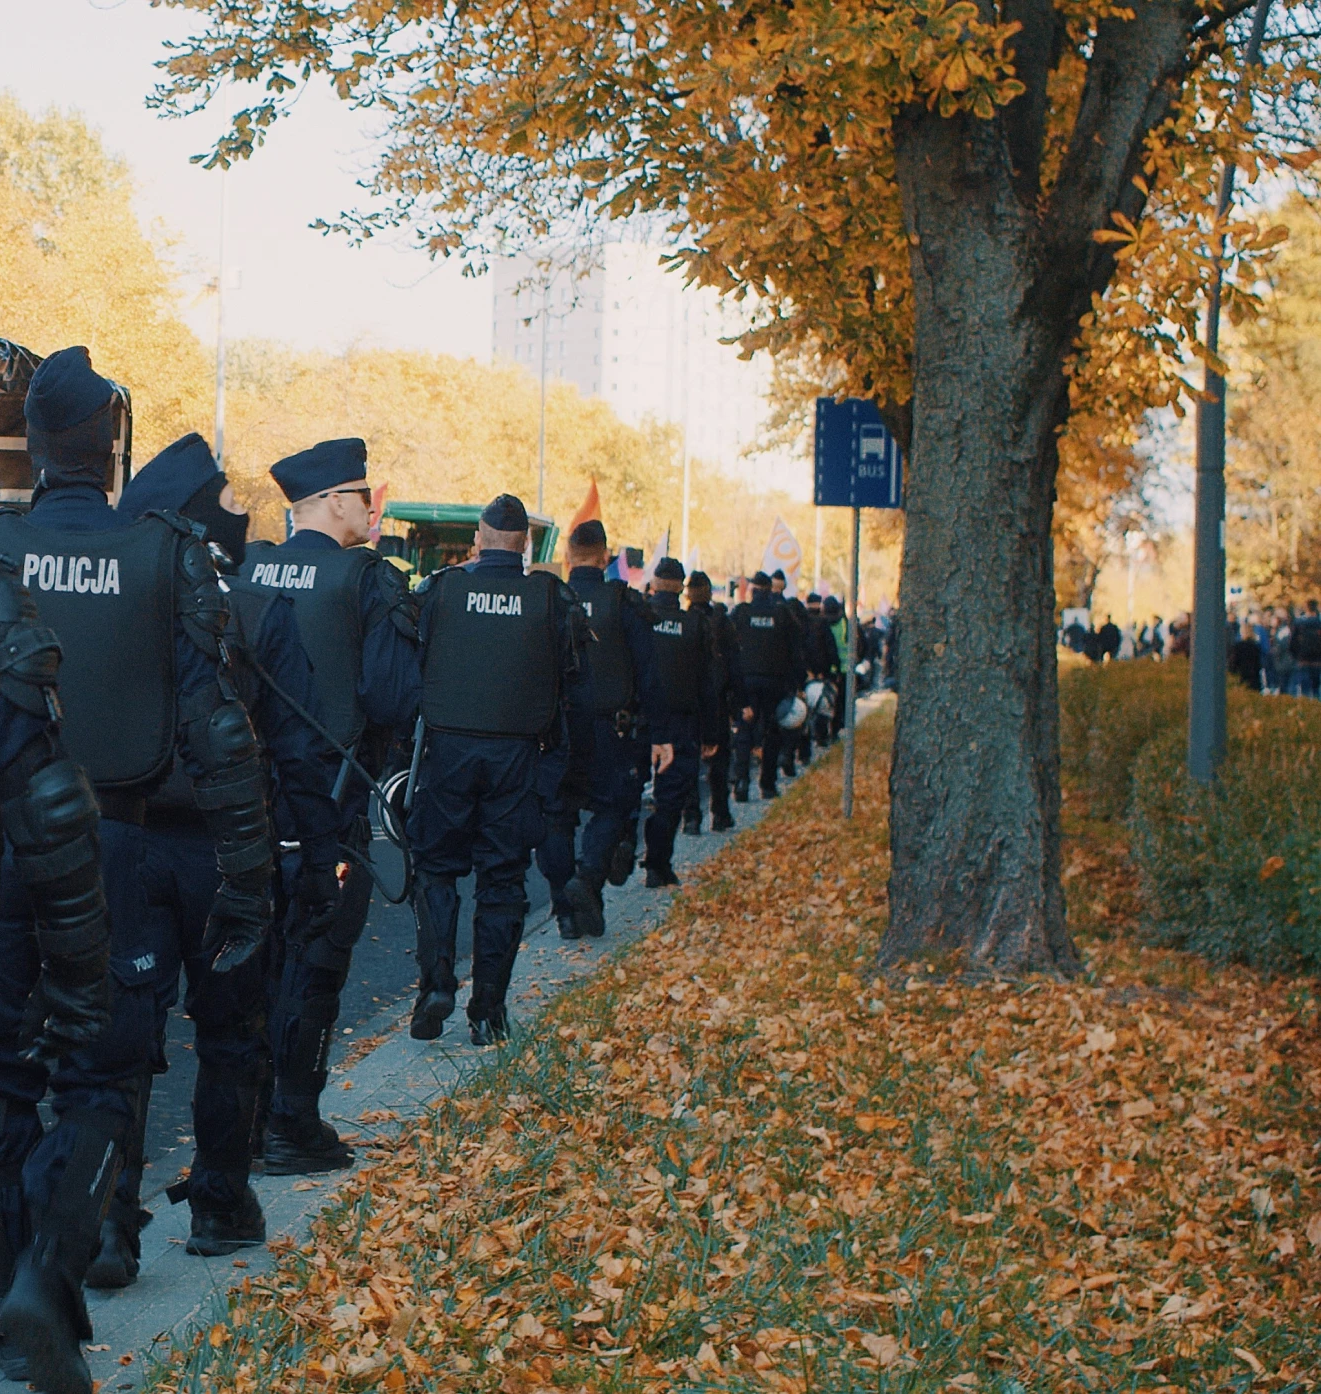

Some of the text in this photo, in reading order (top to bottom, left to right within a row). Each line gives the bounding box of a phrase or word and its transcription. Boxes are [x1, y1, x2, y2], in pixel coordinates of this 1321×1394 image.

[858, 464, 885, 478] BUS
[23, 553, 120, 595] POLICJA
[251, 563, 317, 589] POLICJA
[466, 592, 522, 615] POLICJA
